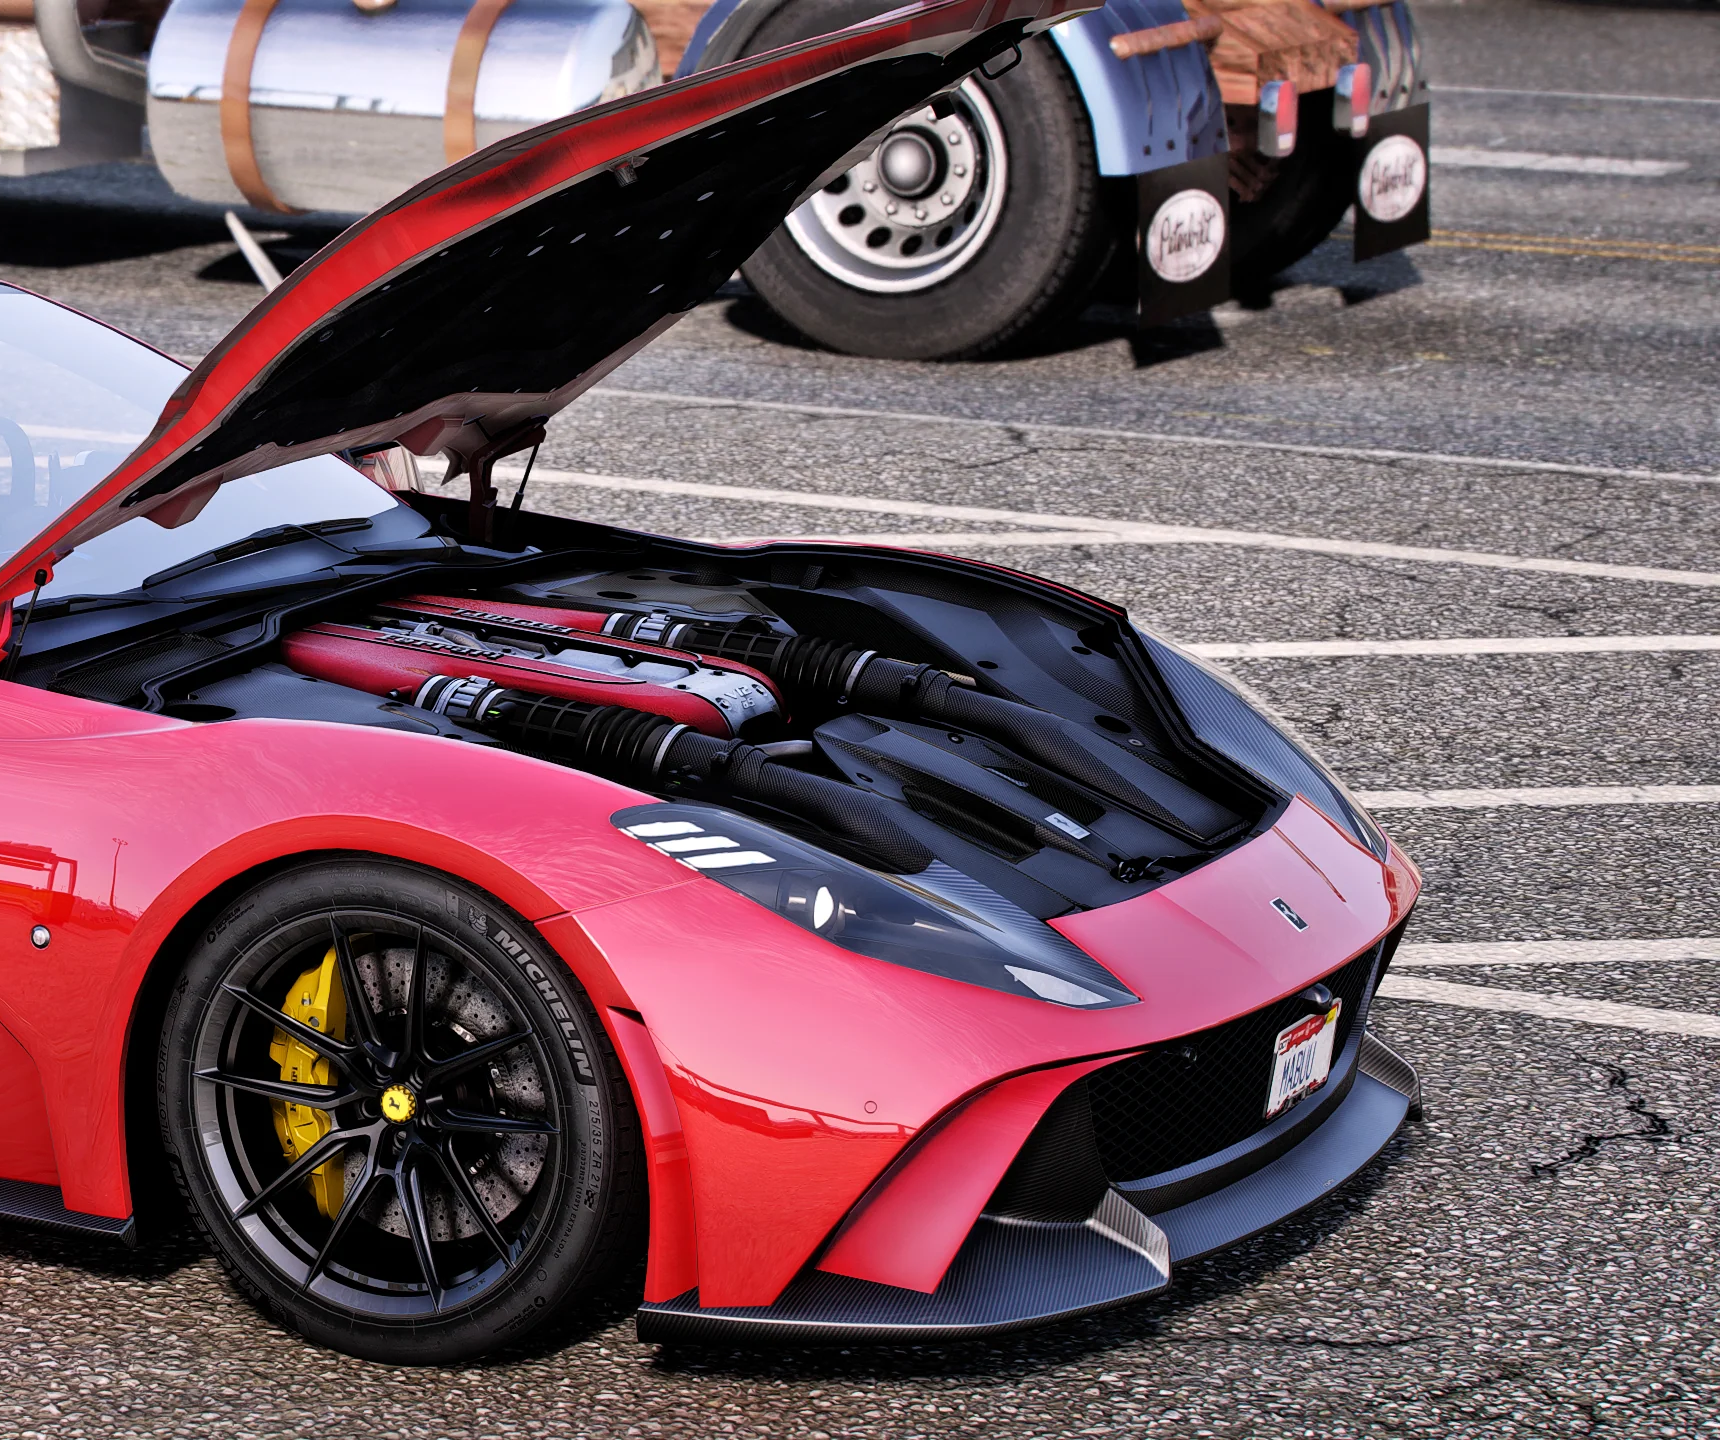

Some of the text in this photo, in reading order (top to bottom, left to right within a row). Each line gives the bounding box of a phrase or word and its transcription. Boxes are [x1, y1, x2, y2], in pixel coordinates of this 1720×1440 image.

[1160, 208, 1216, 263] Peterbilt
[376, 633, 505, 660] Ferrari
[494, 929, 595, 1078] MICHELIN
[158, 1044, 170, 1093] SPORT
[158, 1100, 172, 1145] PILOT
[588, 1100, 602, 1189] 275/35 ZR 21
[553, 1239, 568, 1259] LOAD
[562, 1212, 577, 1239] EXTRA
